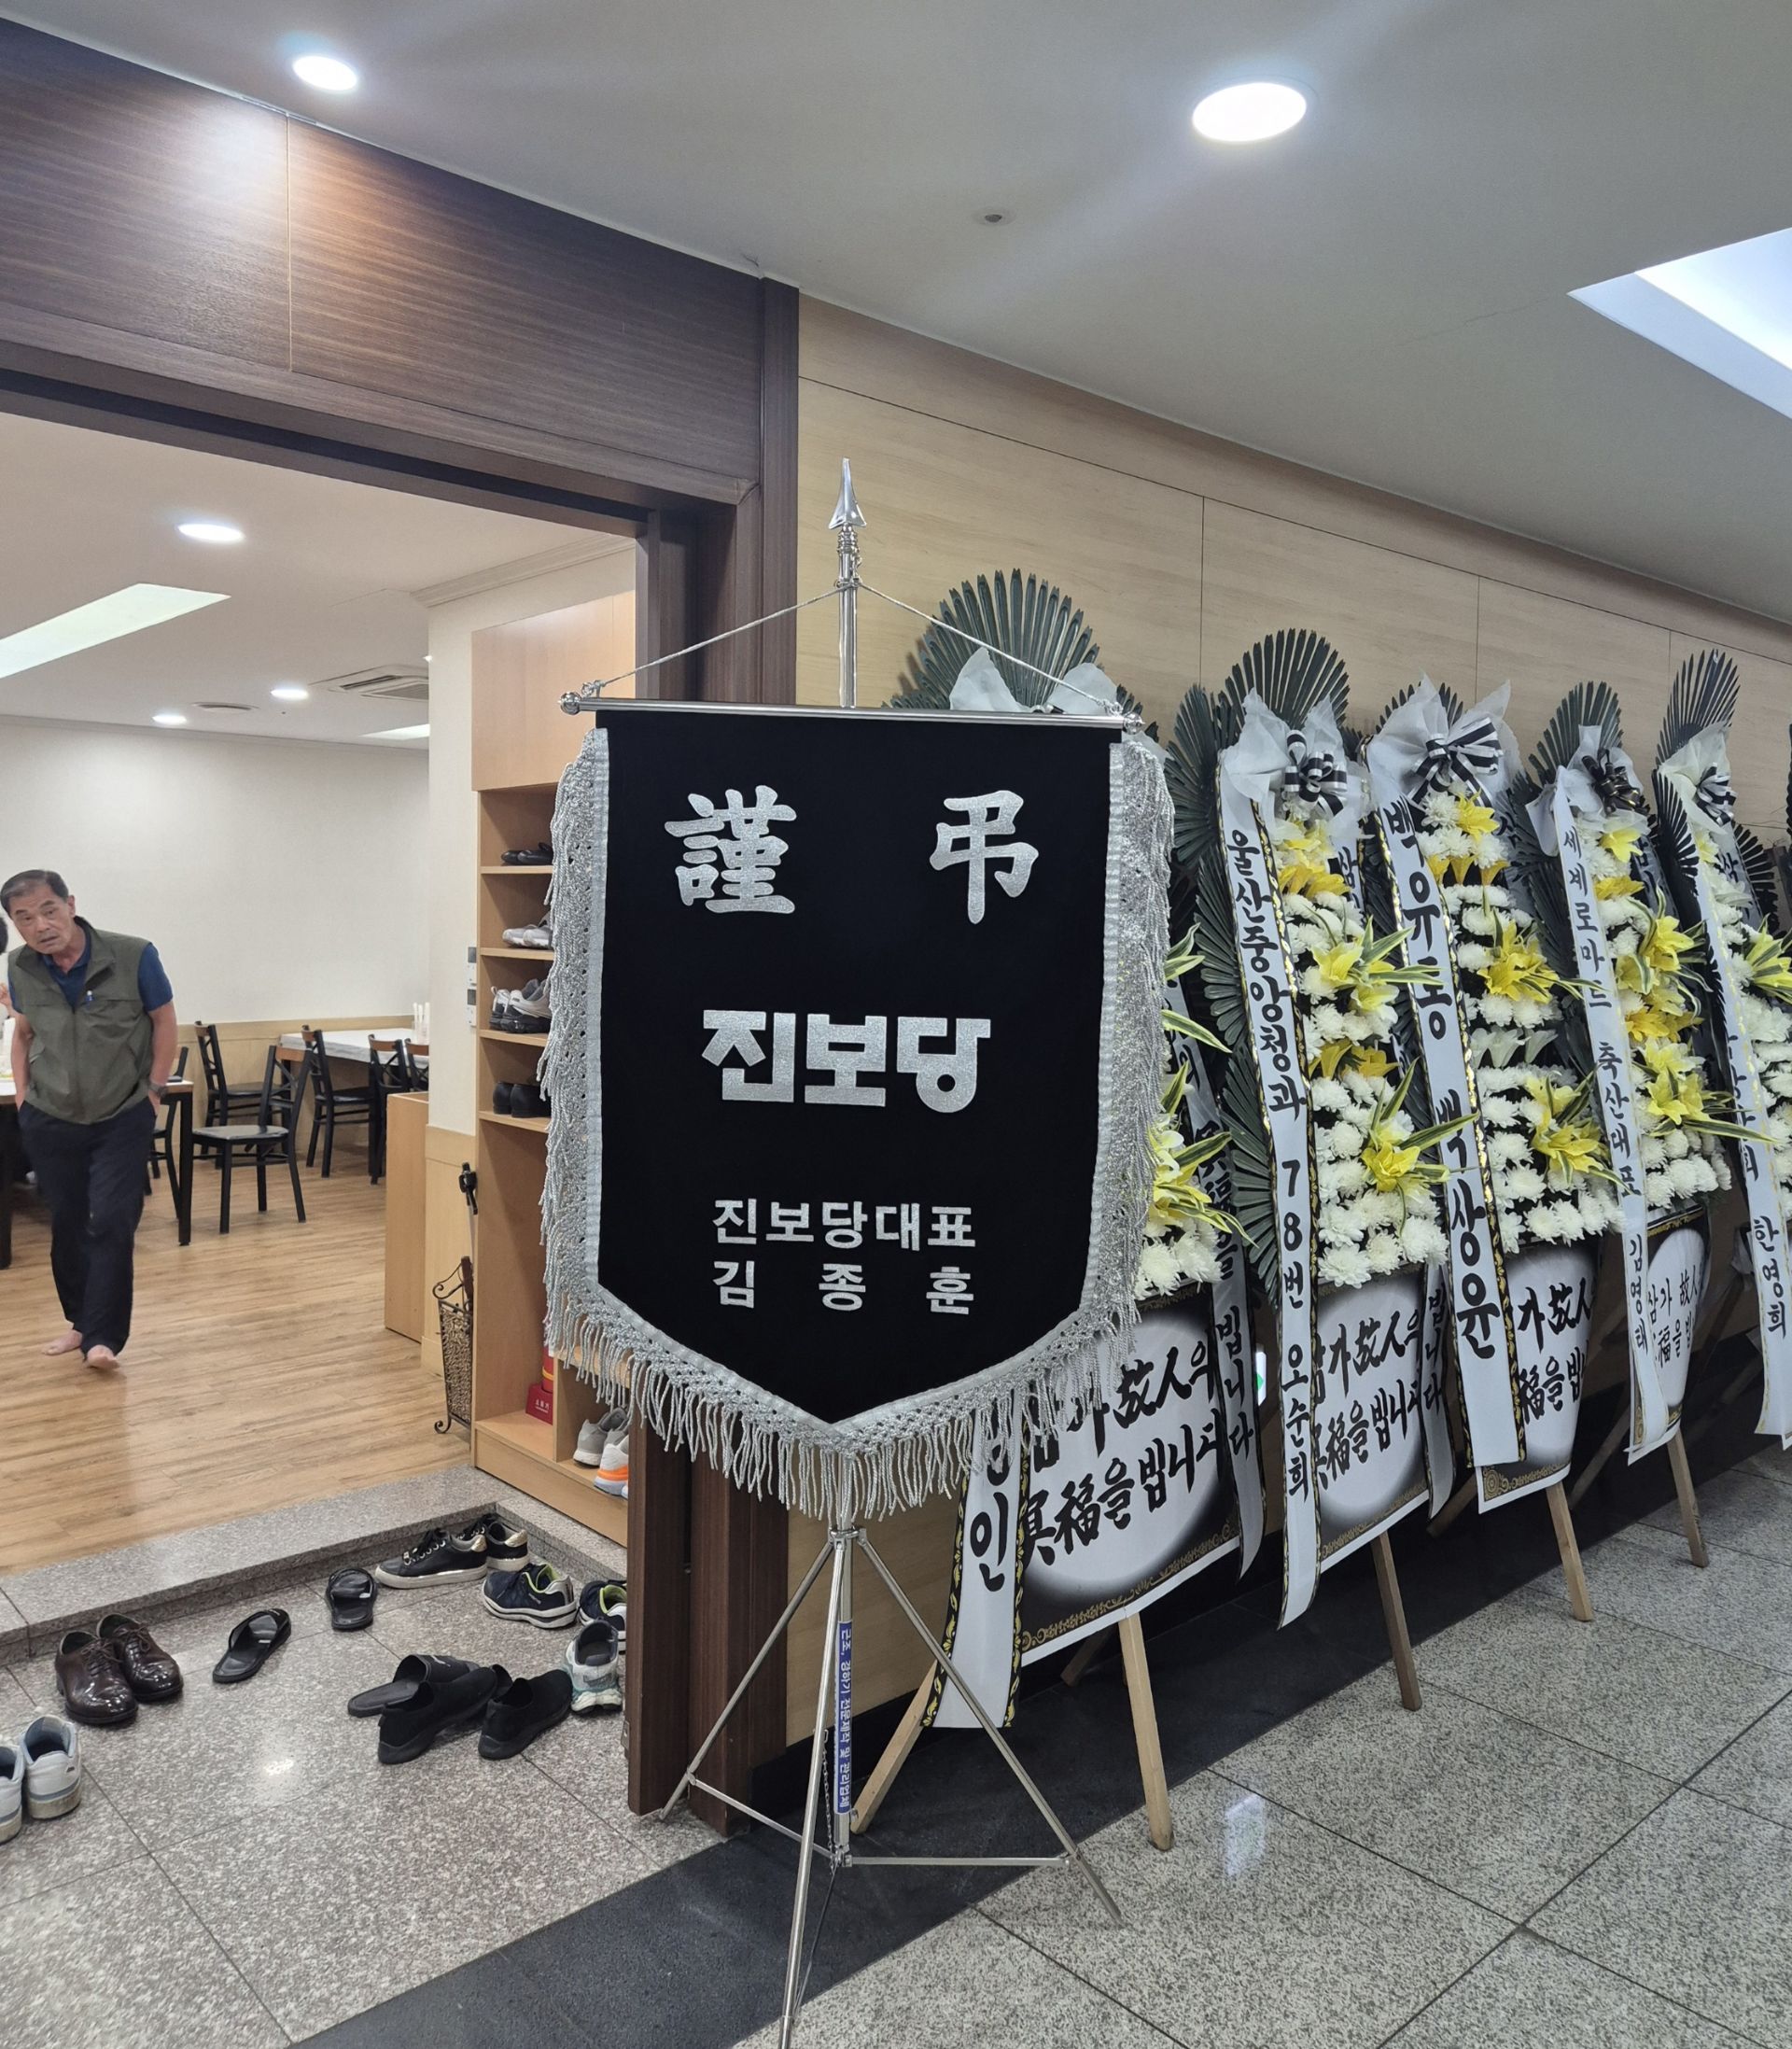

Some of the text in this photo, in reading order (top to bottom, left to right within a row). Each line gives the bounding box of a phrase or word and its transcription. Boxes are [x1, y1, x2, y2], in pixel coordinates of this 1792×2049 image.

[665, 784, 1039, 924] 謹 弔
[701, 1009, 991, 1114] 진보당
[712, 1199, 976, 1252] 진보당대표
[1226, 829, 1307, 1121] 울산중앙청과
[1281, 1344, 1309, 1503] 오순희
[1436, 1088, 1500, 1359] 백상윤
[712, 1260, 974, 1315] 김 종 훈
[1423, 1282, 1447, 1414] 빕니다
[1630, 1233, 1648, 1355] 김영태
[1215, 1305, 1253, 1460] 빕니다
